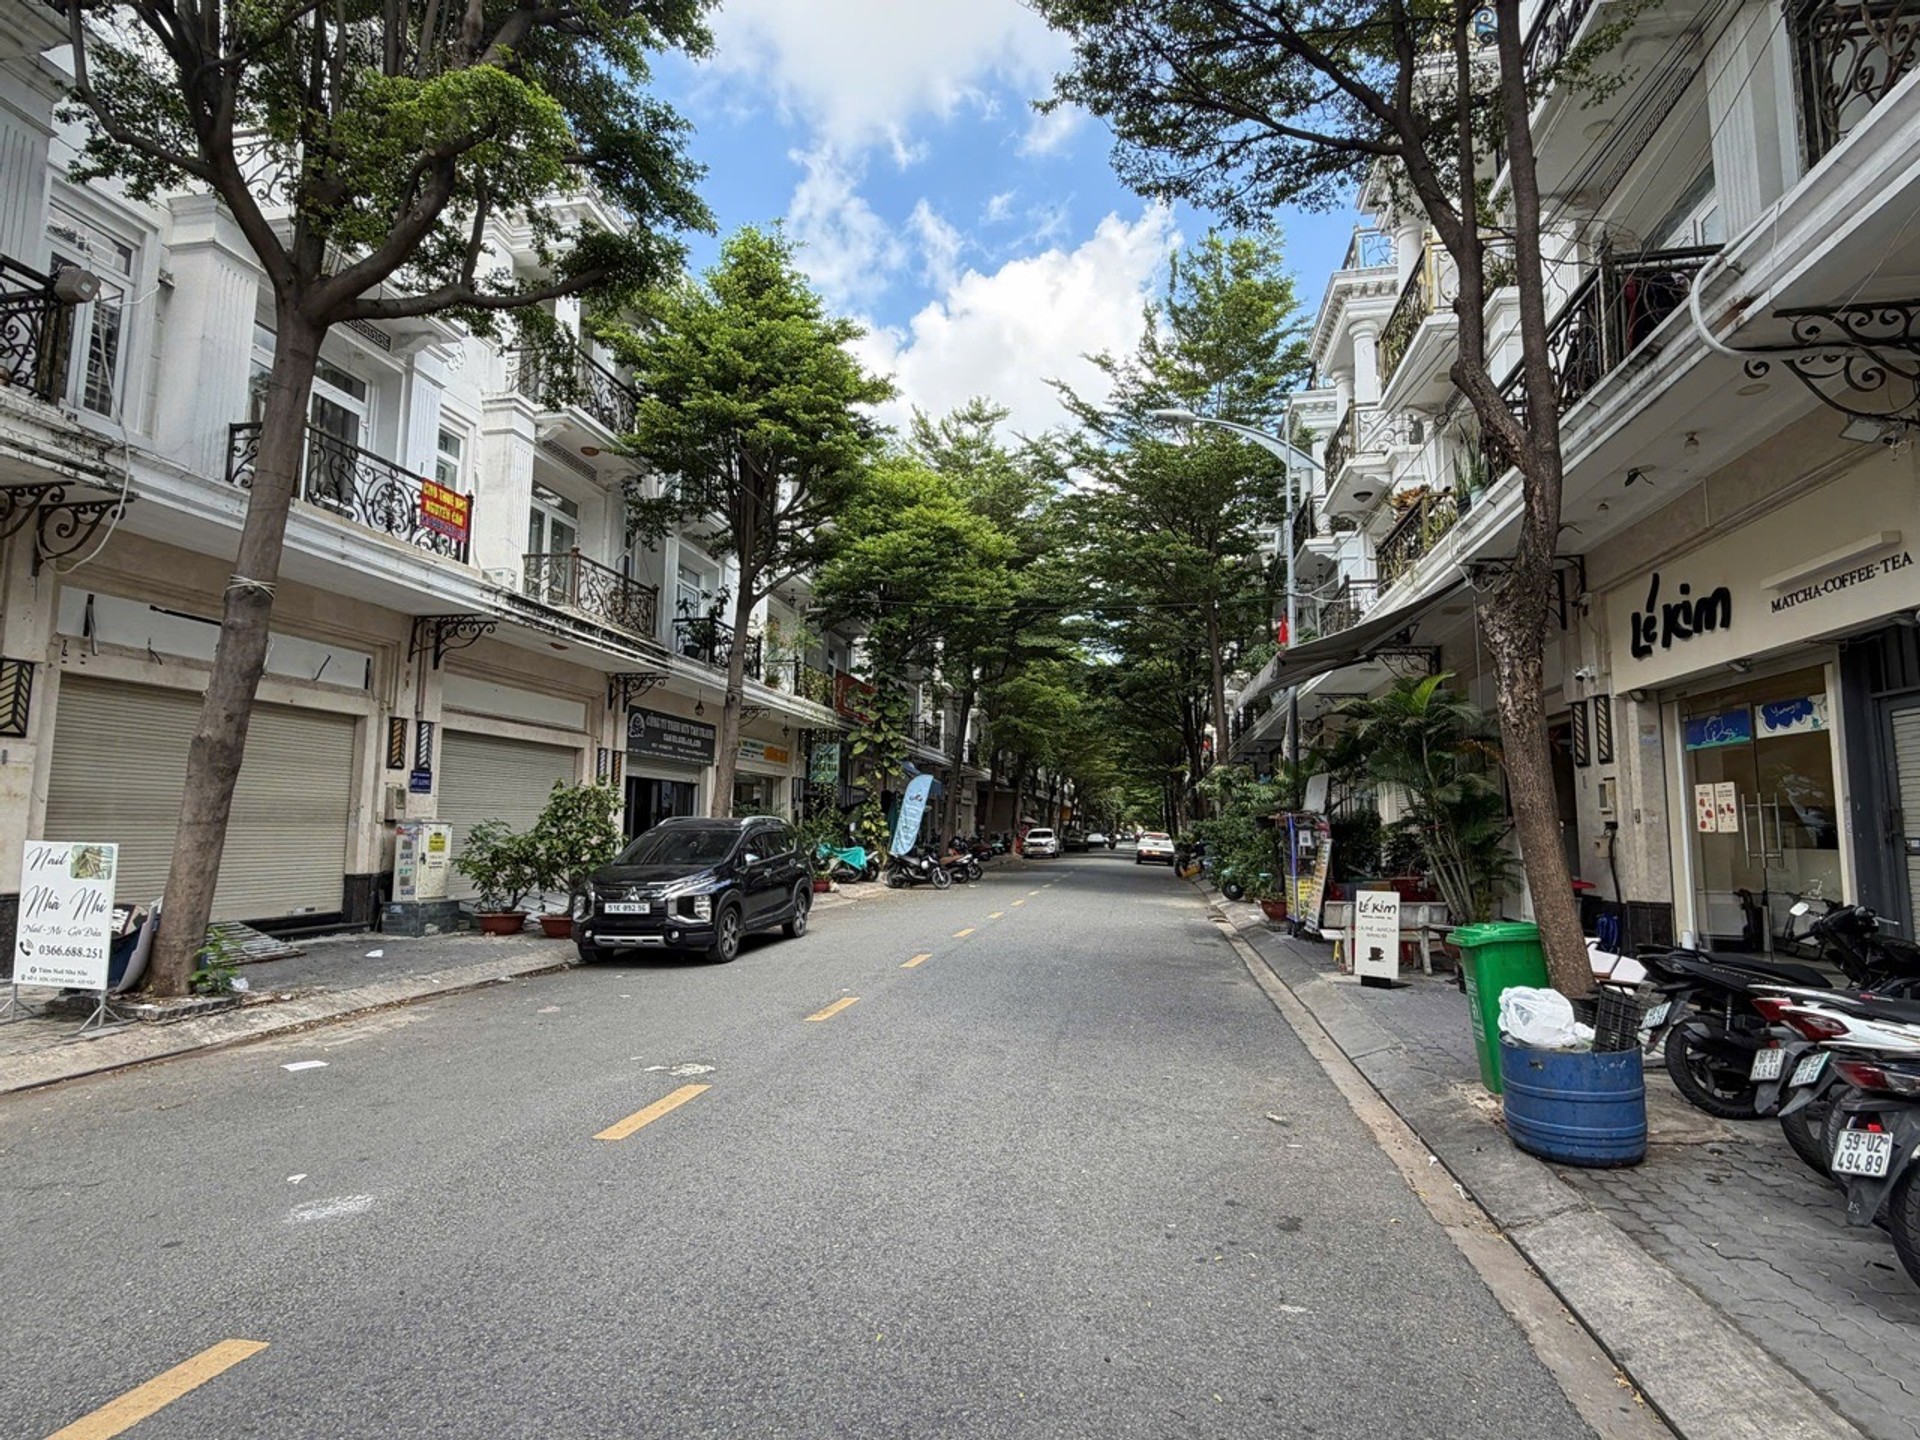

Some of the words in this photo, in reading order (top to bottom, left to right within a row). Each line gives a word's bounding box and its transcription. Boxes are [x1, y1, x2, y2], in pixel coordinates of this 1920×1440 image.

[1771, 551, 1914, 613] MATCHA-COFFEE-TEA
[26, 846, 69, 871] Nail
[22, 885, 62, 918] Nhà
[69, 887, 107, 921] Nhi
[38, 944, 104, 960] 0366.688.251
[1845, 1132, 1884, 1153] 59-U2
[1837, 1152, 1884, 1173] 494.89
